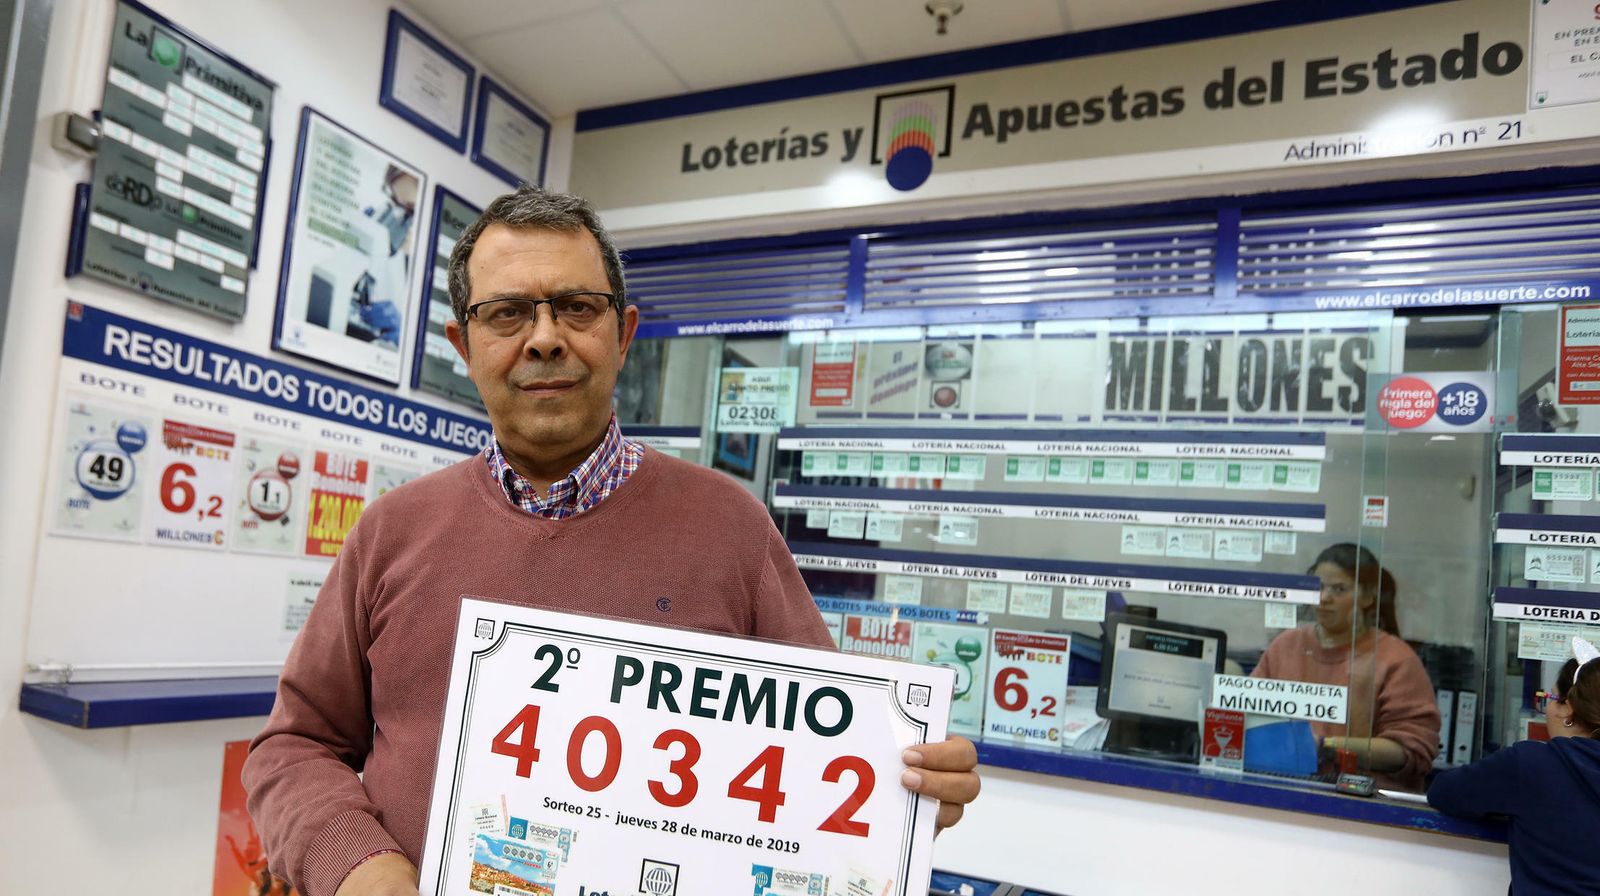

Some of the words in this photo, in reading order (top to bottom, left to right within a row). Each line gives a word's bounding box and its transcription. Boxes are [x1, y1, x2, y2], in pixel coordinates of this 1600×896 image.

[125, 20, 149, 46] La
[185, 56, 263, 111] Primitiva
[681, 128, 828, 173] Loterías
[841, 127, 864, 163] y
[961, 84, 1185, 143] Apuestas
[1203, 59, 1285, 111] del
[1304, 31, 1524, 99] Estado
[1462, 123, 1487, 145] nº
[1498, 120, 1522, 141] 21
[1315, 283, 1591, 309] www.elcarrodelasuerte.com
[80, 372, 146, 395] BOTE
[1104, 336, 1375, 413] MILLONES
[103, 323, 299, 402] RESULTADOS
[304, 379, 384, 424] TODOS
[387, 404, 427, 435] LOS
[430, 416, 493, 452] JUEGO
[1384, 387, 1432, 399] Primera
[173, 393, 229, 415] BOTE
[1414, 398, 1435, 409] del
[1441, 390, 1479, 408] +18
[1443, 405, 1476, 416] años
[253, 412, 302, 431] BOTE
[320, 428, 363, 446] BOTE
[952, 442, 1006, 450] NACIONAL
[381, 442, 418, 459] BOTE
[1037, 443, 1082, 452] LOTERÍA
[1086, 445, 1142, 453] NACIONAL
[1176, 445, 1226, 455] LOTERÍA
[1231, 447, 1294, 456] NACIONAL
[89, 453, 123, 482] 49
[433, 455, 459, 466] BOT
[1533, 455, 1600, 464] LOTERÍA
[159, 462, 223, 521] 6,2
[835, 501, 880, 509] NACIONAL
[952, 505, 1004, 515] NACIONAL
[1035, 509, 1080, 519] LOTERÍA
[1084, 512, 1141, 522] NACIONAL
[1175, 515, 1226, 525] LOTERÍA
[1229, 518, 1293, 529] NACIONAL
[1530, 533, 1597, 545] LOTERÍA
[795, 556, 824, 565] OTERIA
[827, 559, 846, 567] DEL
[848, 561, 877, 569] JUEVES
[942, 567, 961, 576] DEL
[963, 569, 997, 579] JUEVES
[1070, 576, 1091, 586] DEL
[1093, 578, 1132, 588] JUEVES
[1168, 582, 1214, 594] LOTERIA
[1218, 585, 1239, 596] DEL
[1243, 587, 1287, 599] JUEVES
[832, 601, 861, 611] BOTES
[920, 609, 951, 621] BOTES
[1523, 607, 1585, 620] LOTERIA
[860, 618, 896, 638] BOTE
[844, 634, 911, 659] Bonoloto
[1027, 652, 1063, 665] BOTE
[530, 643, 581, 694] 2º
[610, 655, 854, 737] PREMIO
[993, 667, 1057, 719] 6,2
[1218, 677, 1253, 690] PAGO
[1257, 679, 1284, 692] CON
[1288, 683, 1343, 698] TARJETA
[1220, 692, 1297, 716] MÍNIMO
[1304, 703, 1338, 720] 10€
[543, 796, 583, 816] Sorteo
[586, 805, 602, 819] 25
[614, 810, 658, 831] jueves
[661, 819, 677, 834] 28
[681, 823, 698, 837] de
[700, 828, 743, 844] marzo
[746, 833, 764, 849] de
[767, 837, 801, 854] 2019
